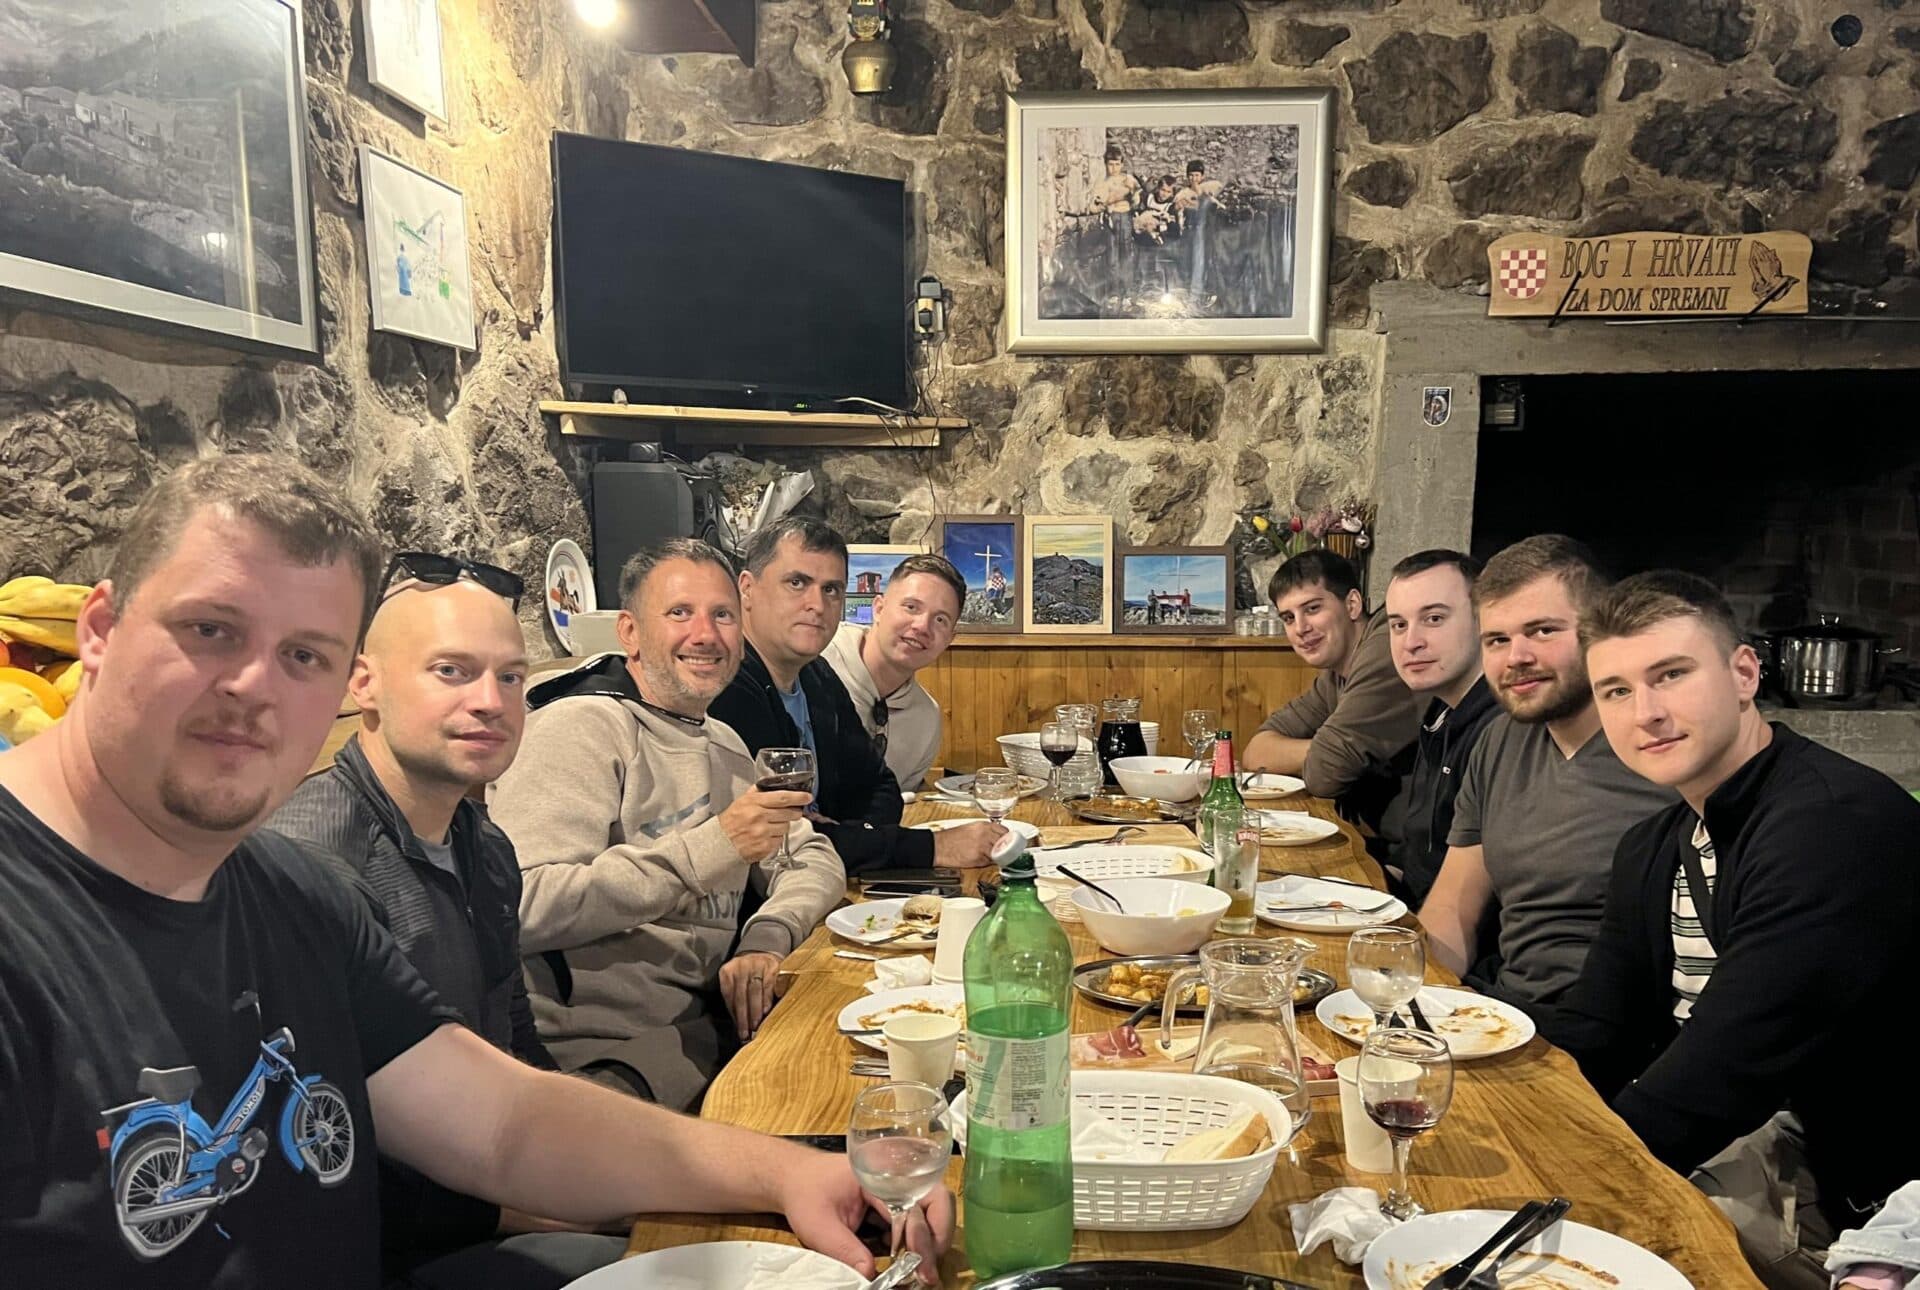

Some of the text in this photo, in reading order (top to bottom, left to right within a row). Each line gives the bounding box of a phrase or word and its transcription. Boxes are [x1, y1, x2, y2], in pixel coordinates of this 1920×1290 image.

[1560, 238, 1742, 278] BOG I HRVATI
[1566, 287, 1731, 311] ZA DOM SPREMNI
